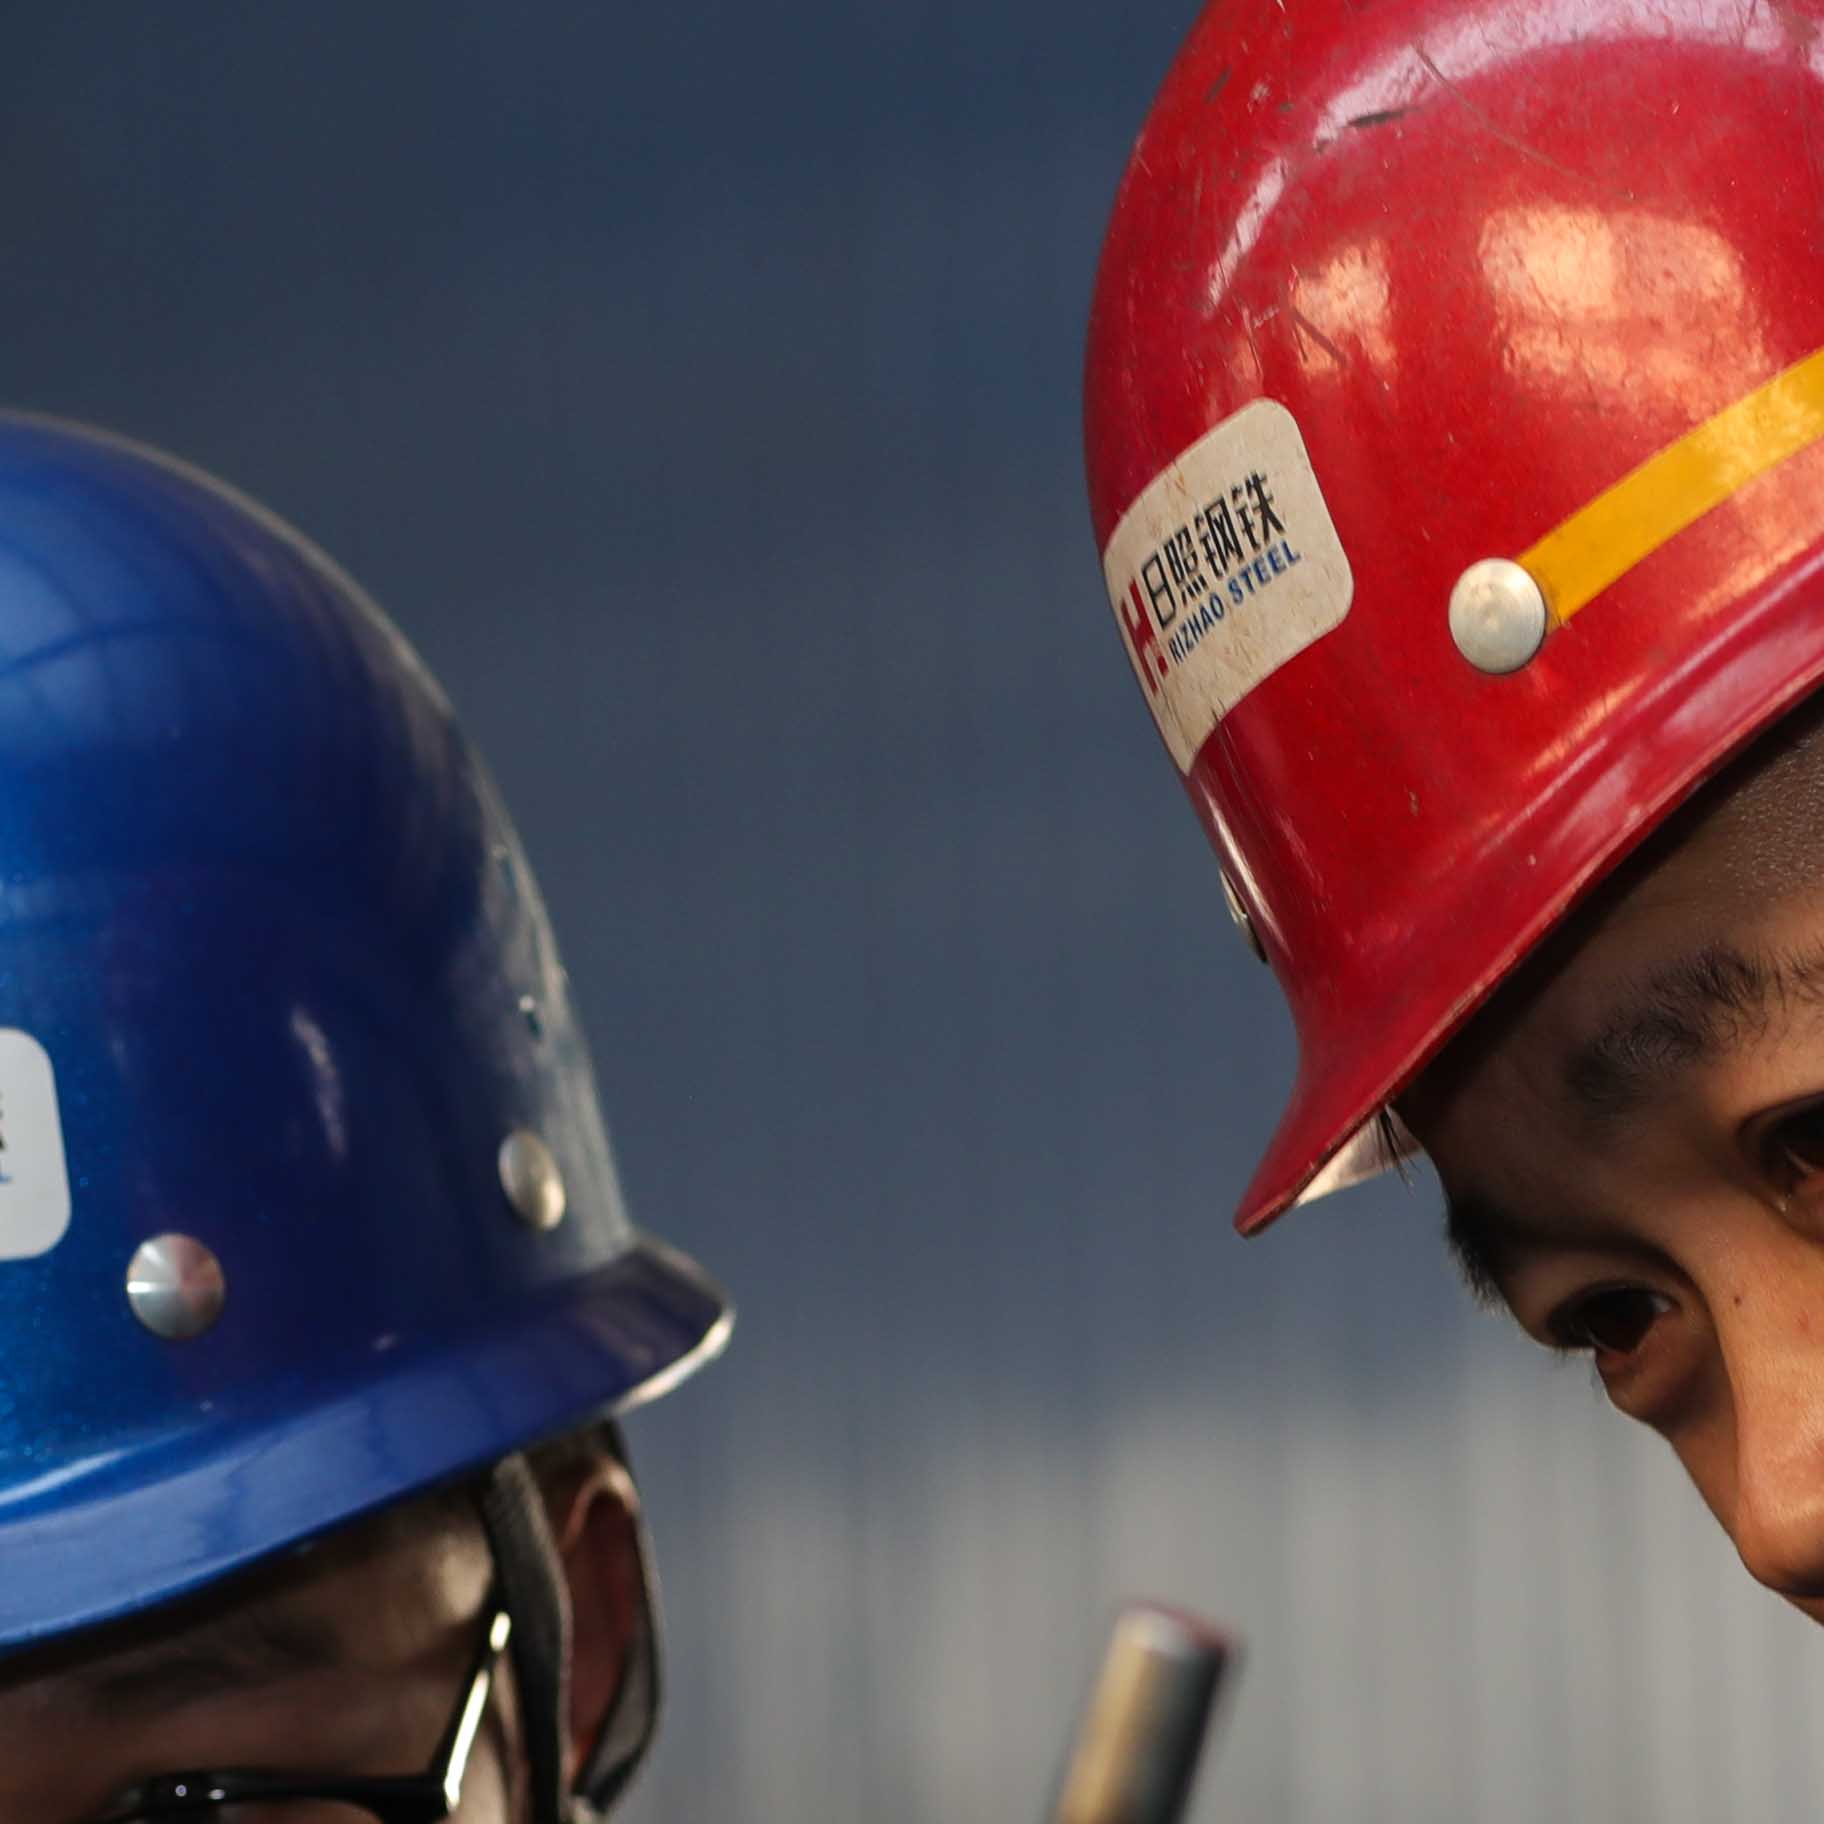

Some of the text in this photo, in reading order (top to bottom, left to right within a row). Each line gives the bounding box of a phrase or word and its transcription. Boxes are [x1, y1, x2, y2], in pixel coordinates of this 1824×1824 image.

[1141, 471, 1285, 628] 日照钢铁
[1169, 541, 1301, 664] RIZHAO STEEL
